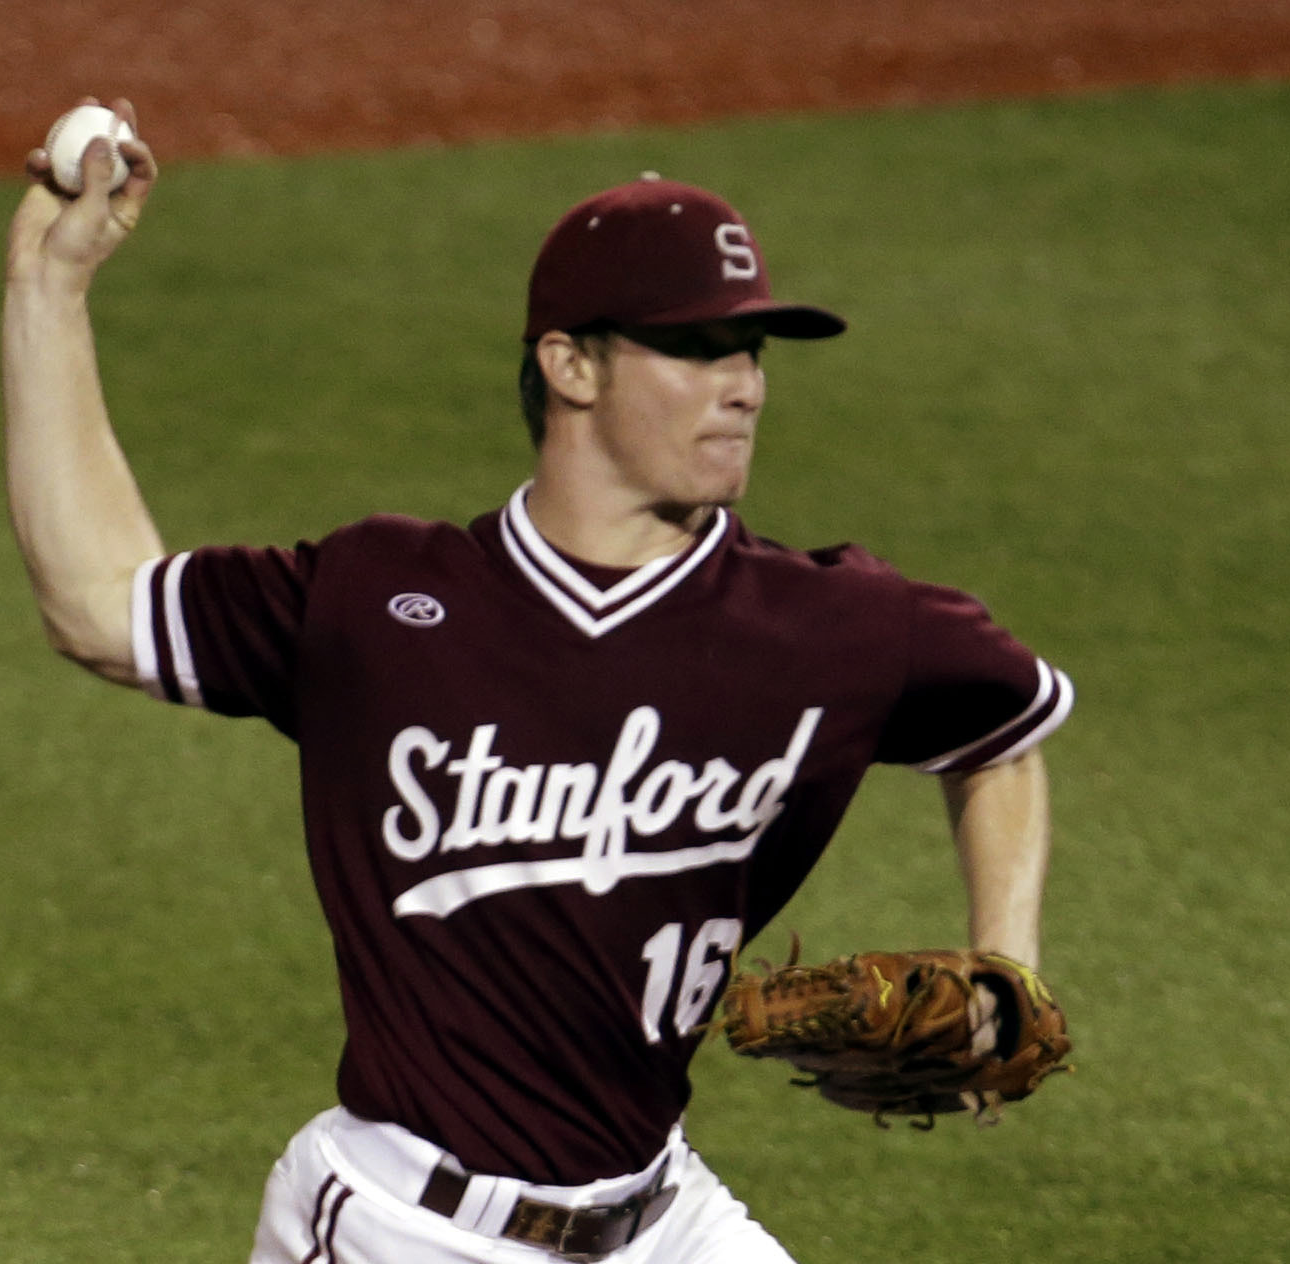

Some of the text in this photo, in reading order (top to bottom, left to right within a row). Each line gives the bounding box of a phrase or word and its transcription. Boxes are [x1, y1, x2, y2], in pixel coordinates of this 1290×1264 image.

[715, 223, 758, 280] S
[382, 705, 824, 895] Stanford
[641, 918, 742, 1044] 16
